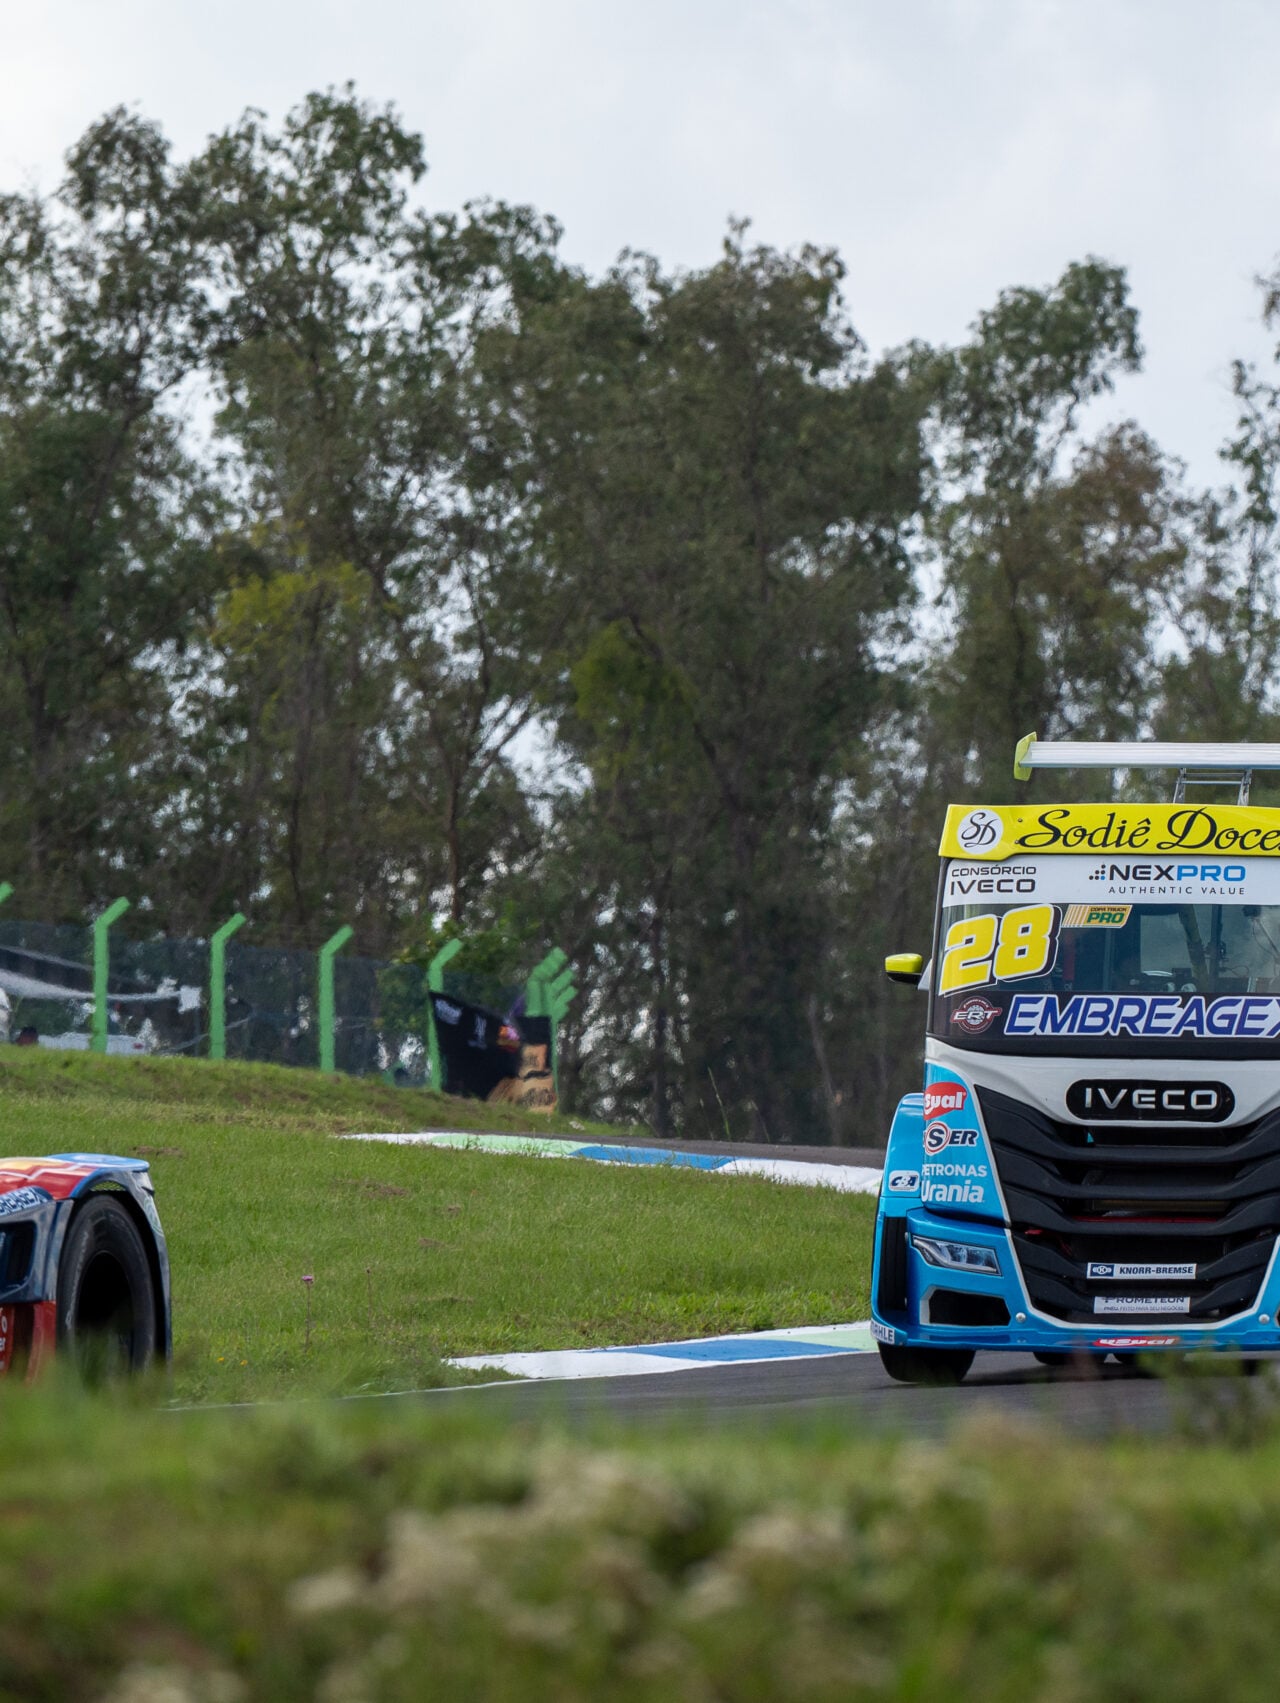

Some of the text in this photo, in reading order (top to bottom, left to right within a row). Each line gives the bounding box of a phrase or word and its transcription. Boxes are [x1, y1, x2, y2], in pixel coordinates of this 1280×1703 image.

[1019, 809, 1152, 848] Sodiê
[951, 864, 1037, 877] CONSÓRCIO
[1109, 864, 1246, 882] NEXPRO
[950, 879, 1036, 895] IVECO
[1108, 886, 1245, 896] AUTHENTIC VALUE
[1086, 911, 1125, 924] PRO
[939, 903, 1060, 996] 28
[953, 1009, 1000, 1020] ERT
[1085, 1087, 1218, 1110] IVECO
[921, 1180, 984, 1203] Urania
[1119, 1266, 1193, 1275] KNORR-BREMSE
